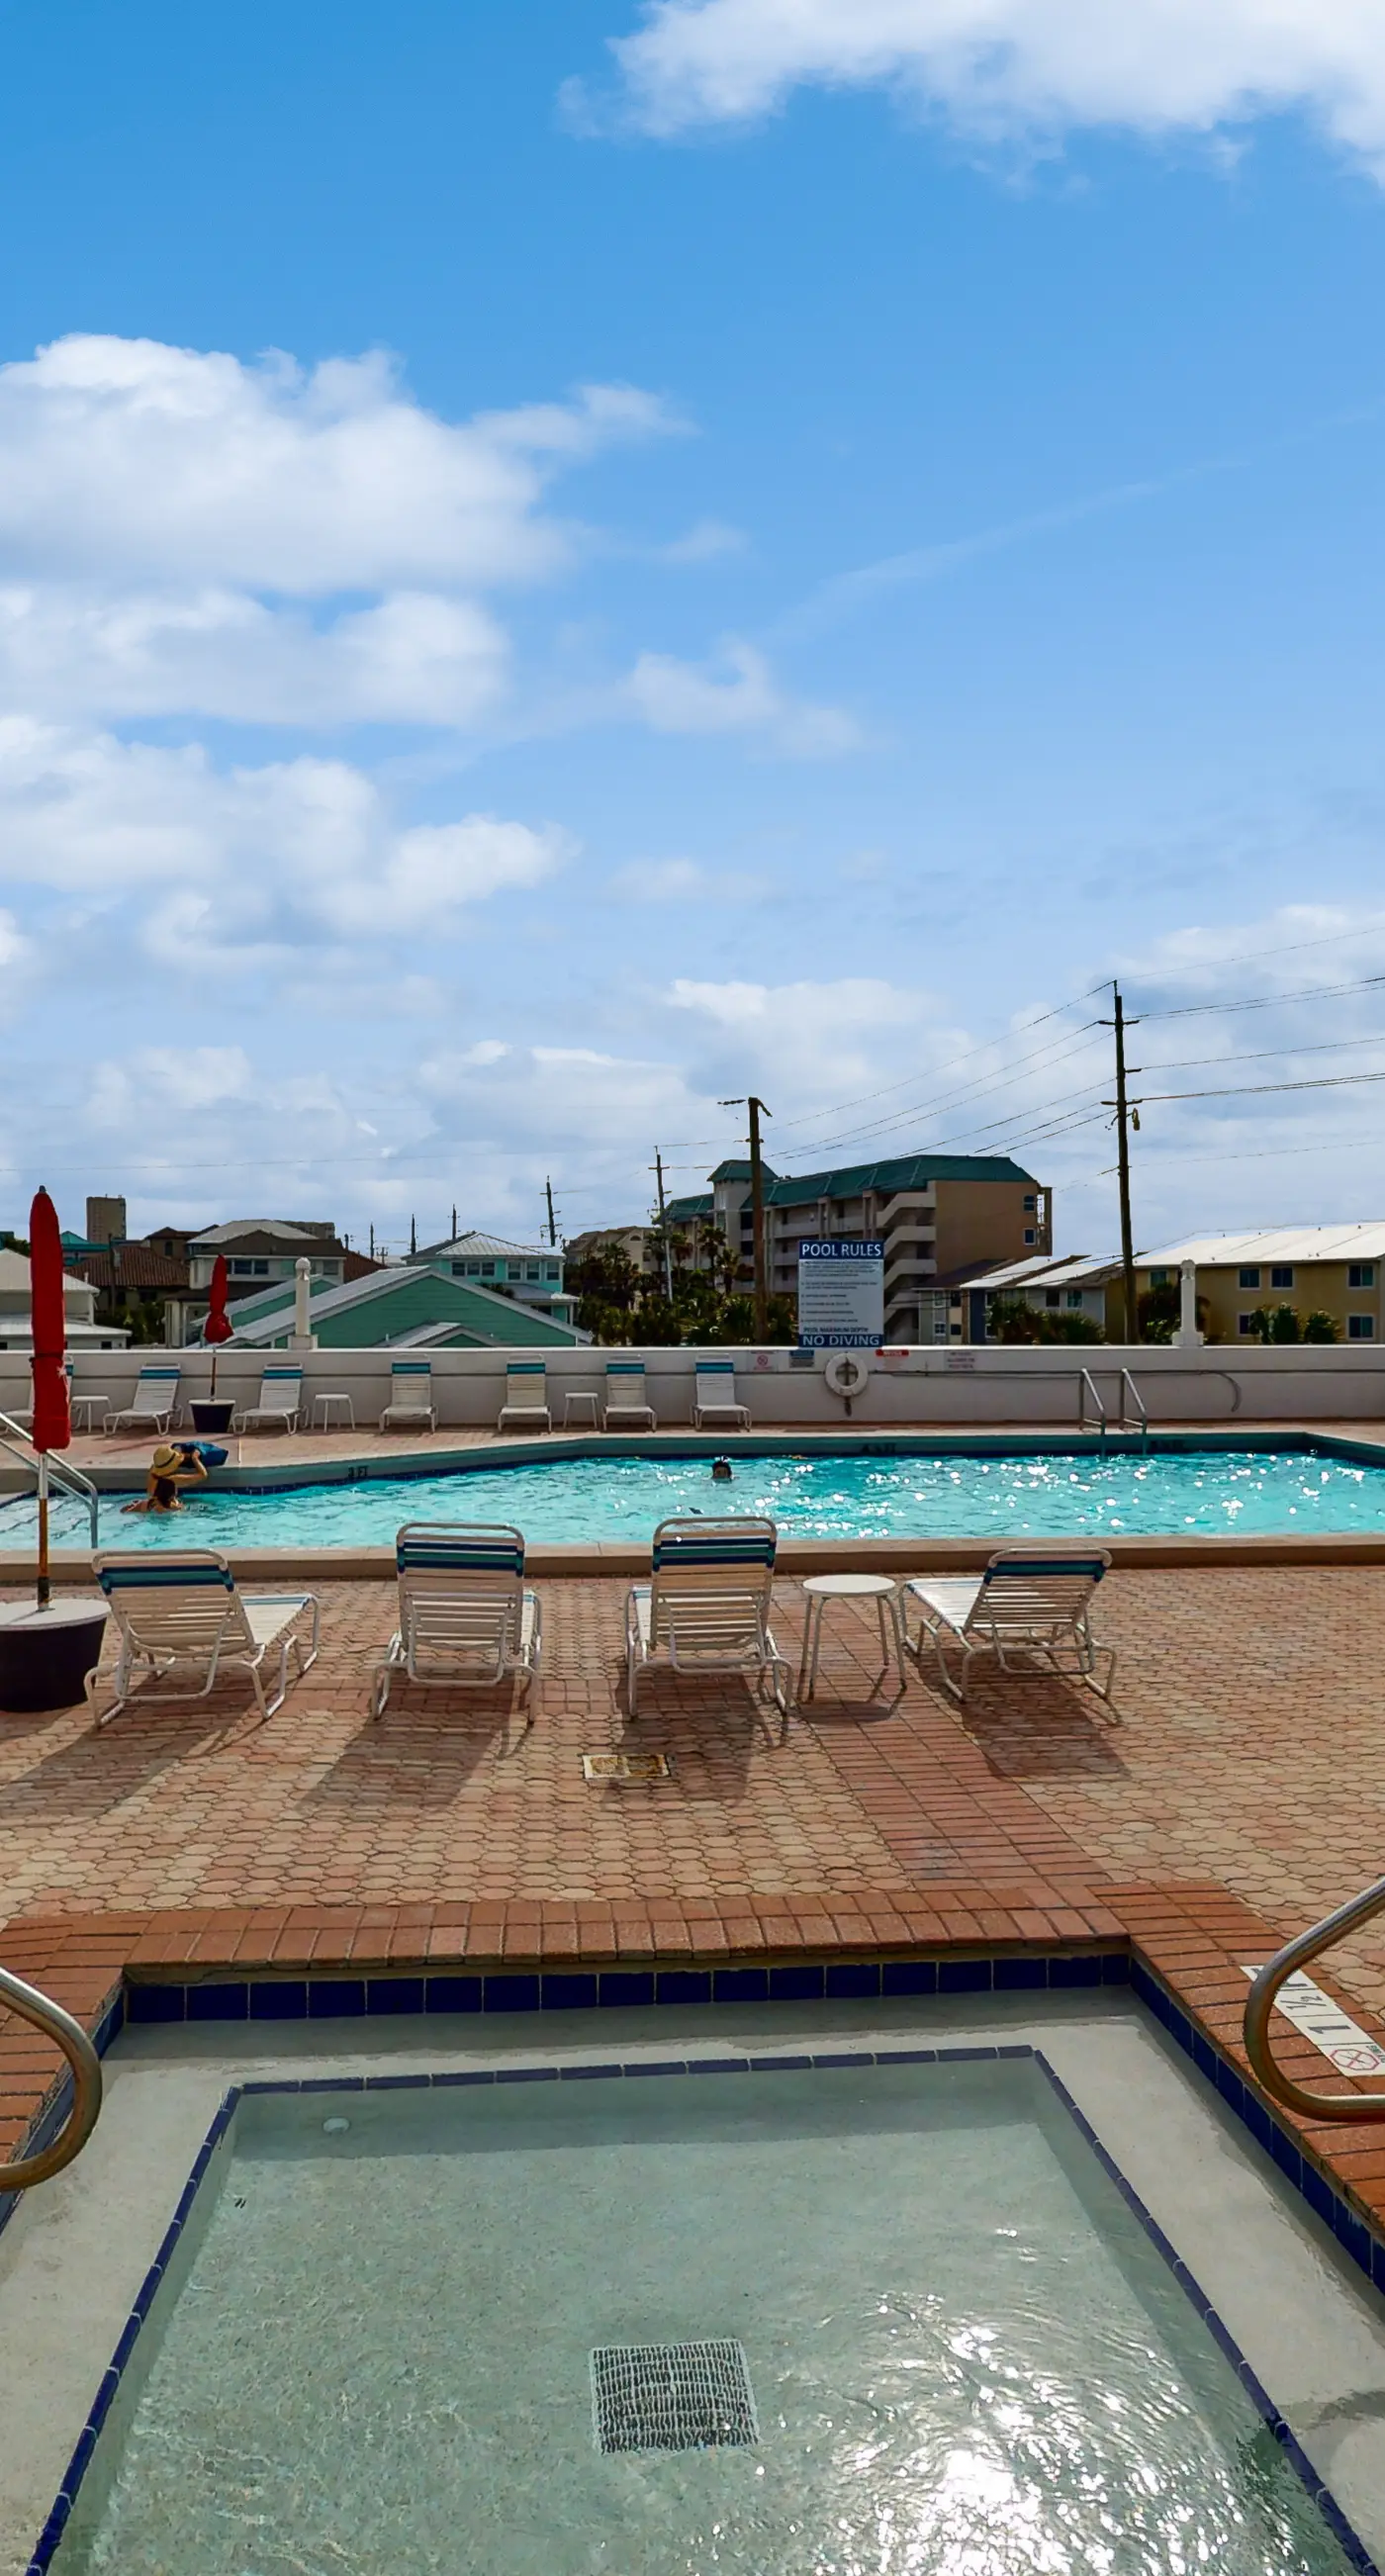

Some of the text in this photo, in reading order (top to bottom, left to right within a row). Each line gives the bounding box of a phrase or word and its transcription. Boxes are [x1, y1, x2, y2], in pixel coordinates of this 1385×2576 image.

[801, 1243, 881, 1256] POOL RULES
[802, 1335, 879, 1345] NO DIVING
